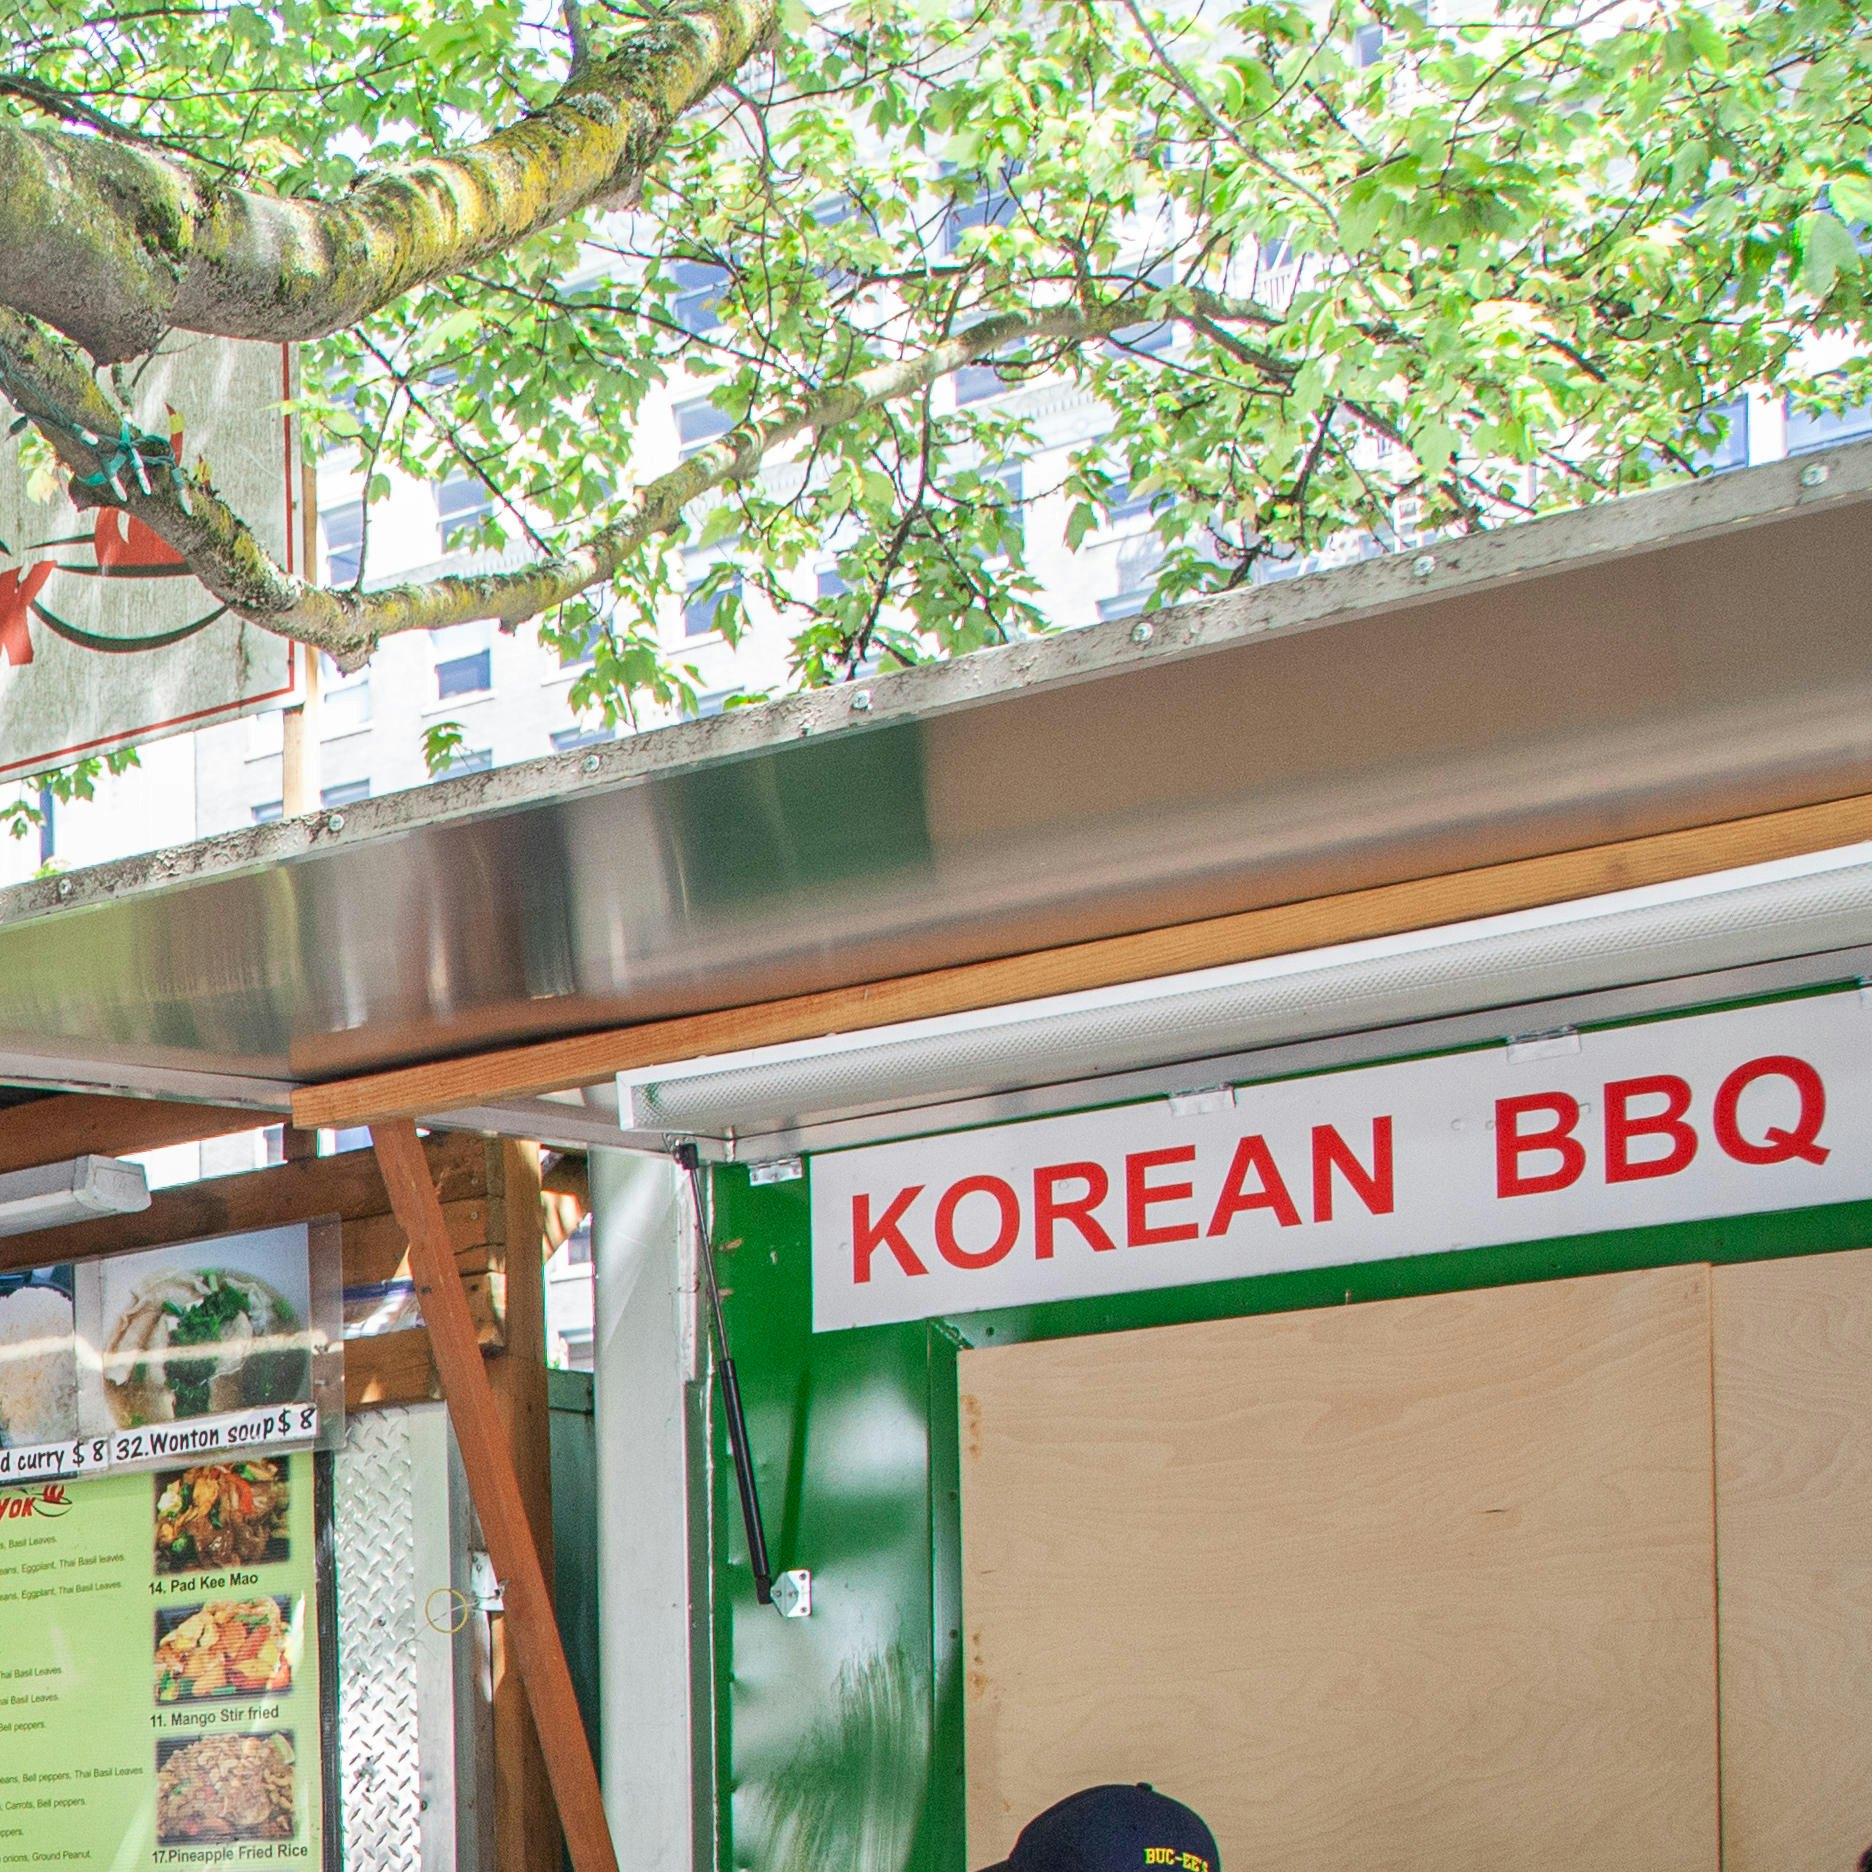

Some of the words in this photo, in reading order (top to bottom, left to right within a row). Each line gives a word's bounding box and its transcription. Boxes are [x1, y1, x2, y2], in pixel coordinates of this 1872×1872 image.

[850, 1114, 1394, 1285] KOREAN
[1493, 1055, 1832, 1200] BBQ
[116, 1429, 219, 1460] 32.Wonton
[227, 1417, 274, 1443] soup
[278, 1409, 291, 1435] $
[300, 1407, 315, 1429] 8
[17, 1448, 65, 1472] curry
[72, 1441, 85, 1466] $
[93, 1439, 105, 1461] 8
[149, 1581, 166, 1594] 14.
[171, 1578, 195, 1592] Pad
[201, 1576, 225, 1589] Kee
[230, 1573, 258, 1586] Mao
[152, 1842, 235, 1864] 17.Pineapple
[239, 1841, 272, 1859] Fried
[276, 1840, 307, 1857] Rice
